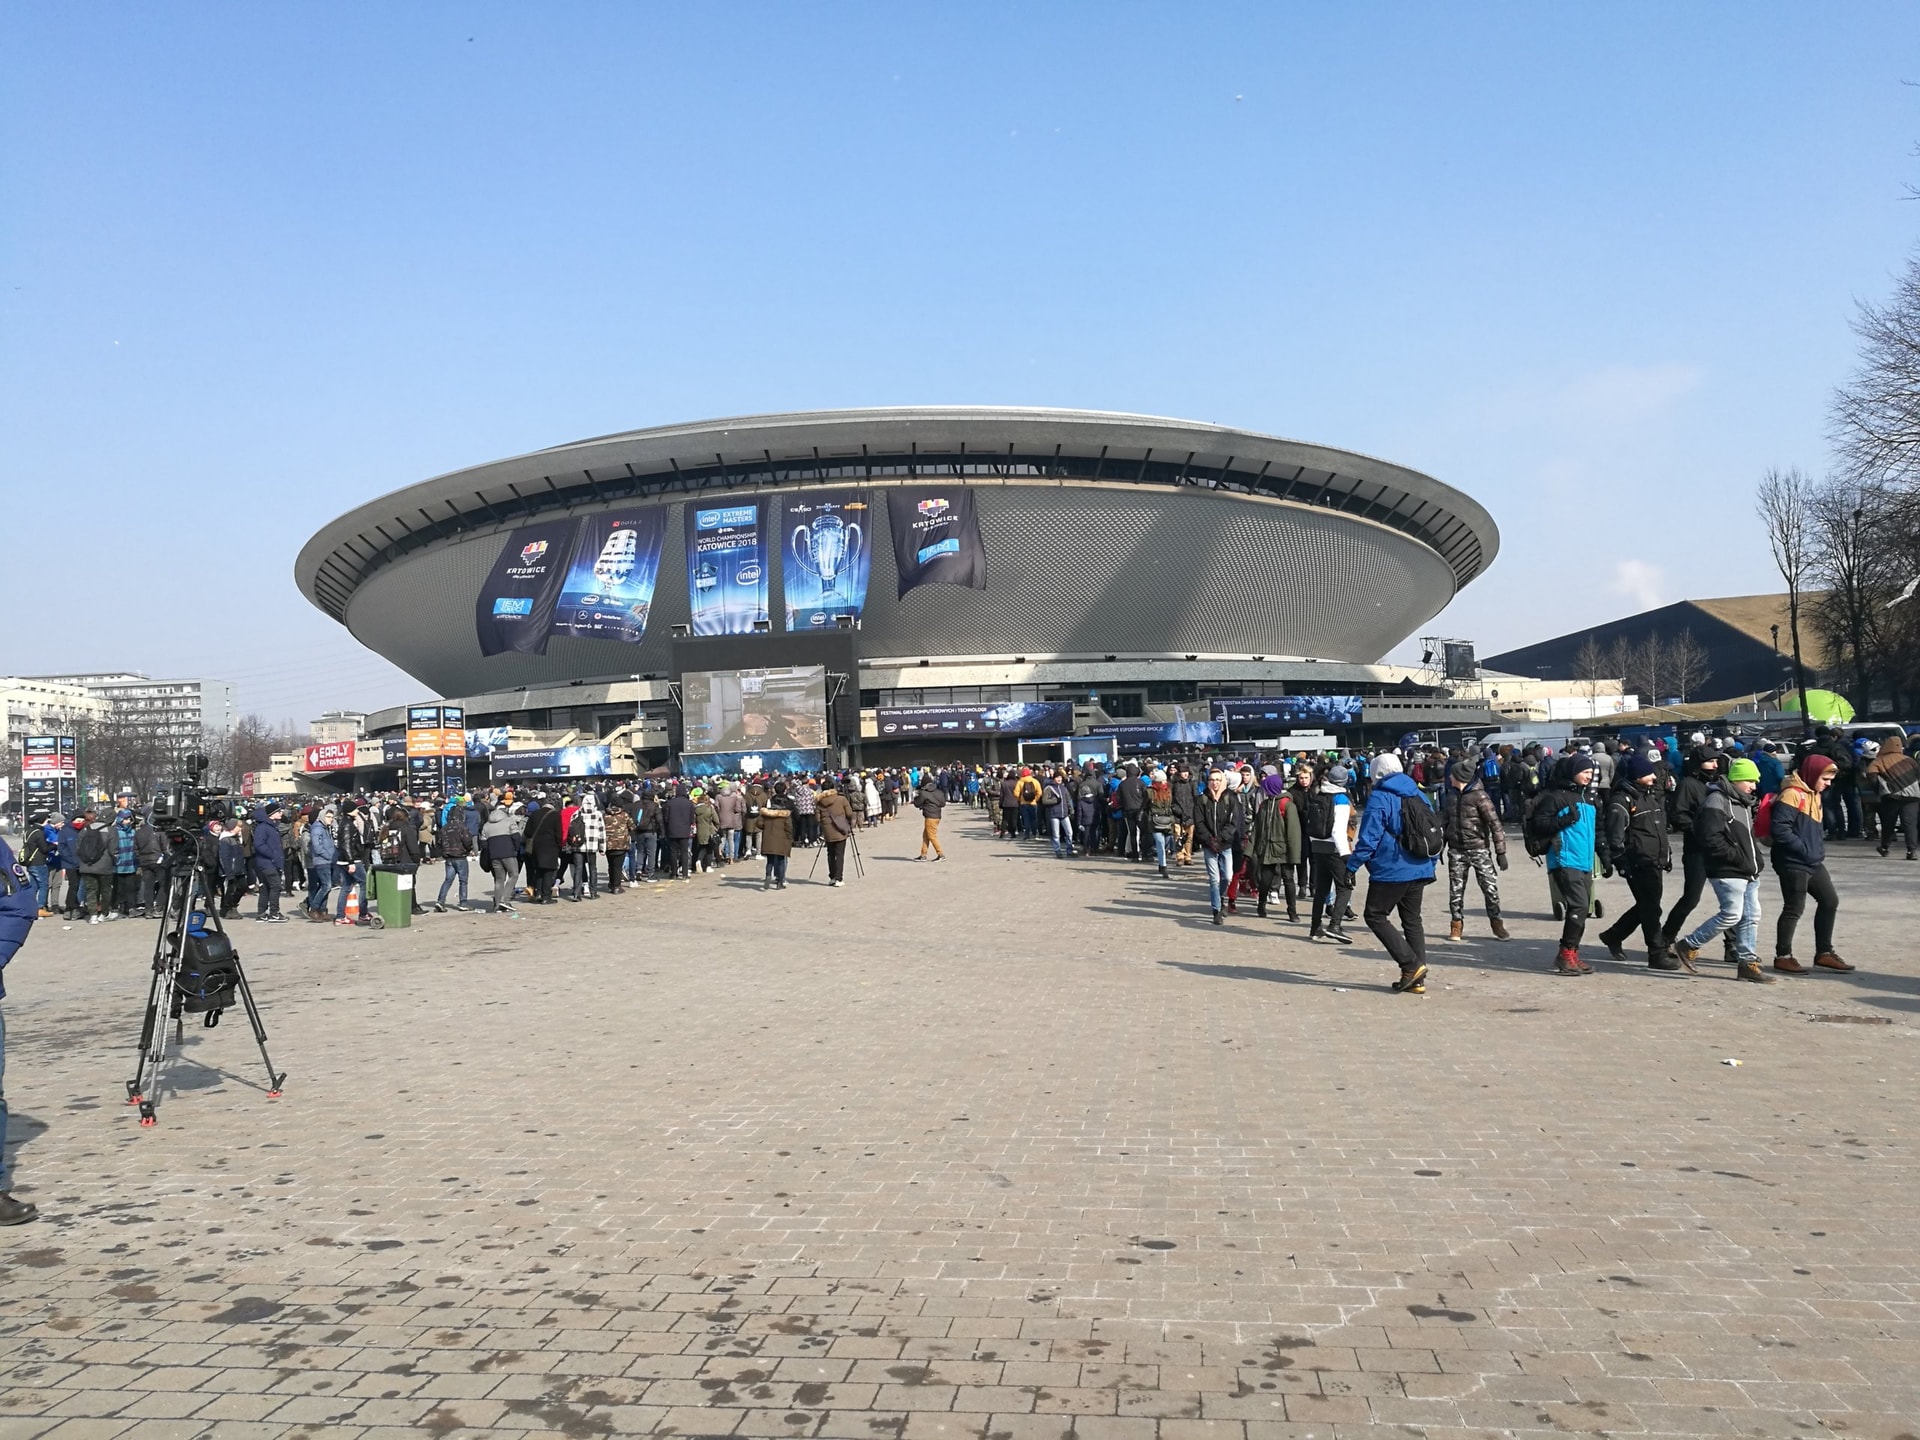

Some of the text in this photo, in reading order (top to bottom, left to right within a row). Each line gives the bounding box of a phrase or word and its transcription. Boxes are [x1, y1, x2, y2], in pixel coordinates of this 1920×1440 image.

[722, 509, 753, 518] EXTREME
[722, 516, 753, 524] MASTERS
[912, 516, 959, 529] KATOWICE
[716, 532, 757, 542] CHAMPIONSHIP
[697, 538, 757, 552] KATOWICE 2018
[506, 566, 546, 574] KATOWICE
[319, 744, 349, 758] EARLY
[319, 758, 350, 767] ENTRANCE
